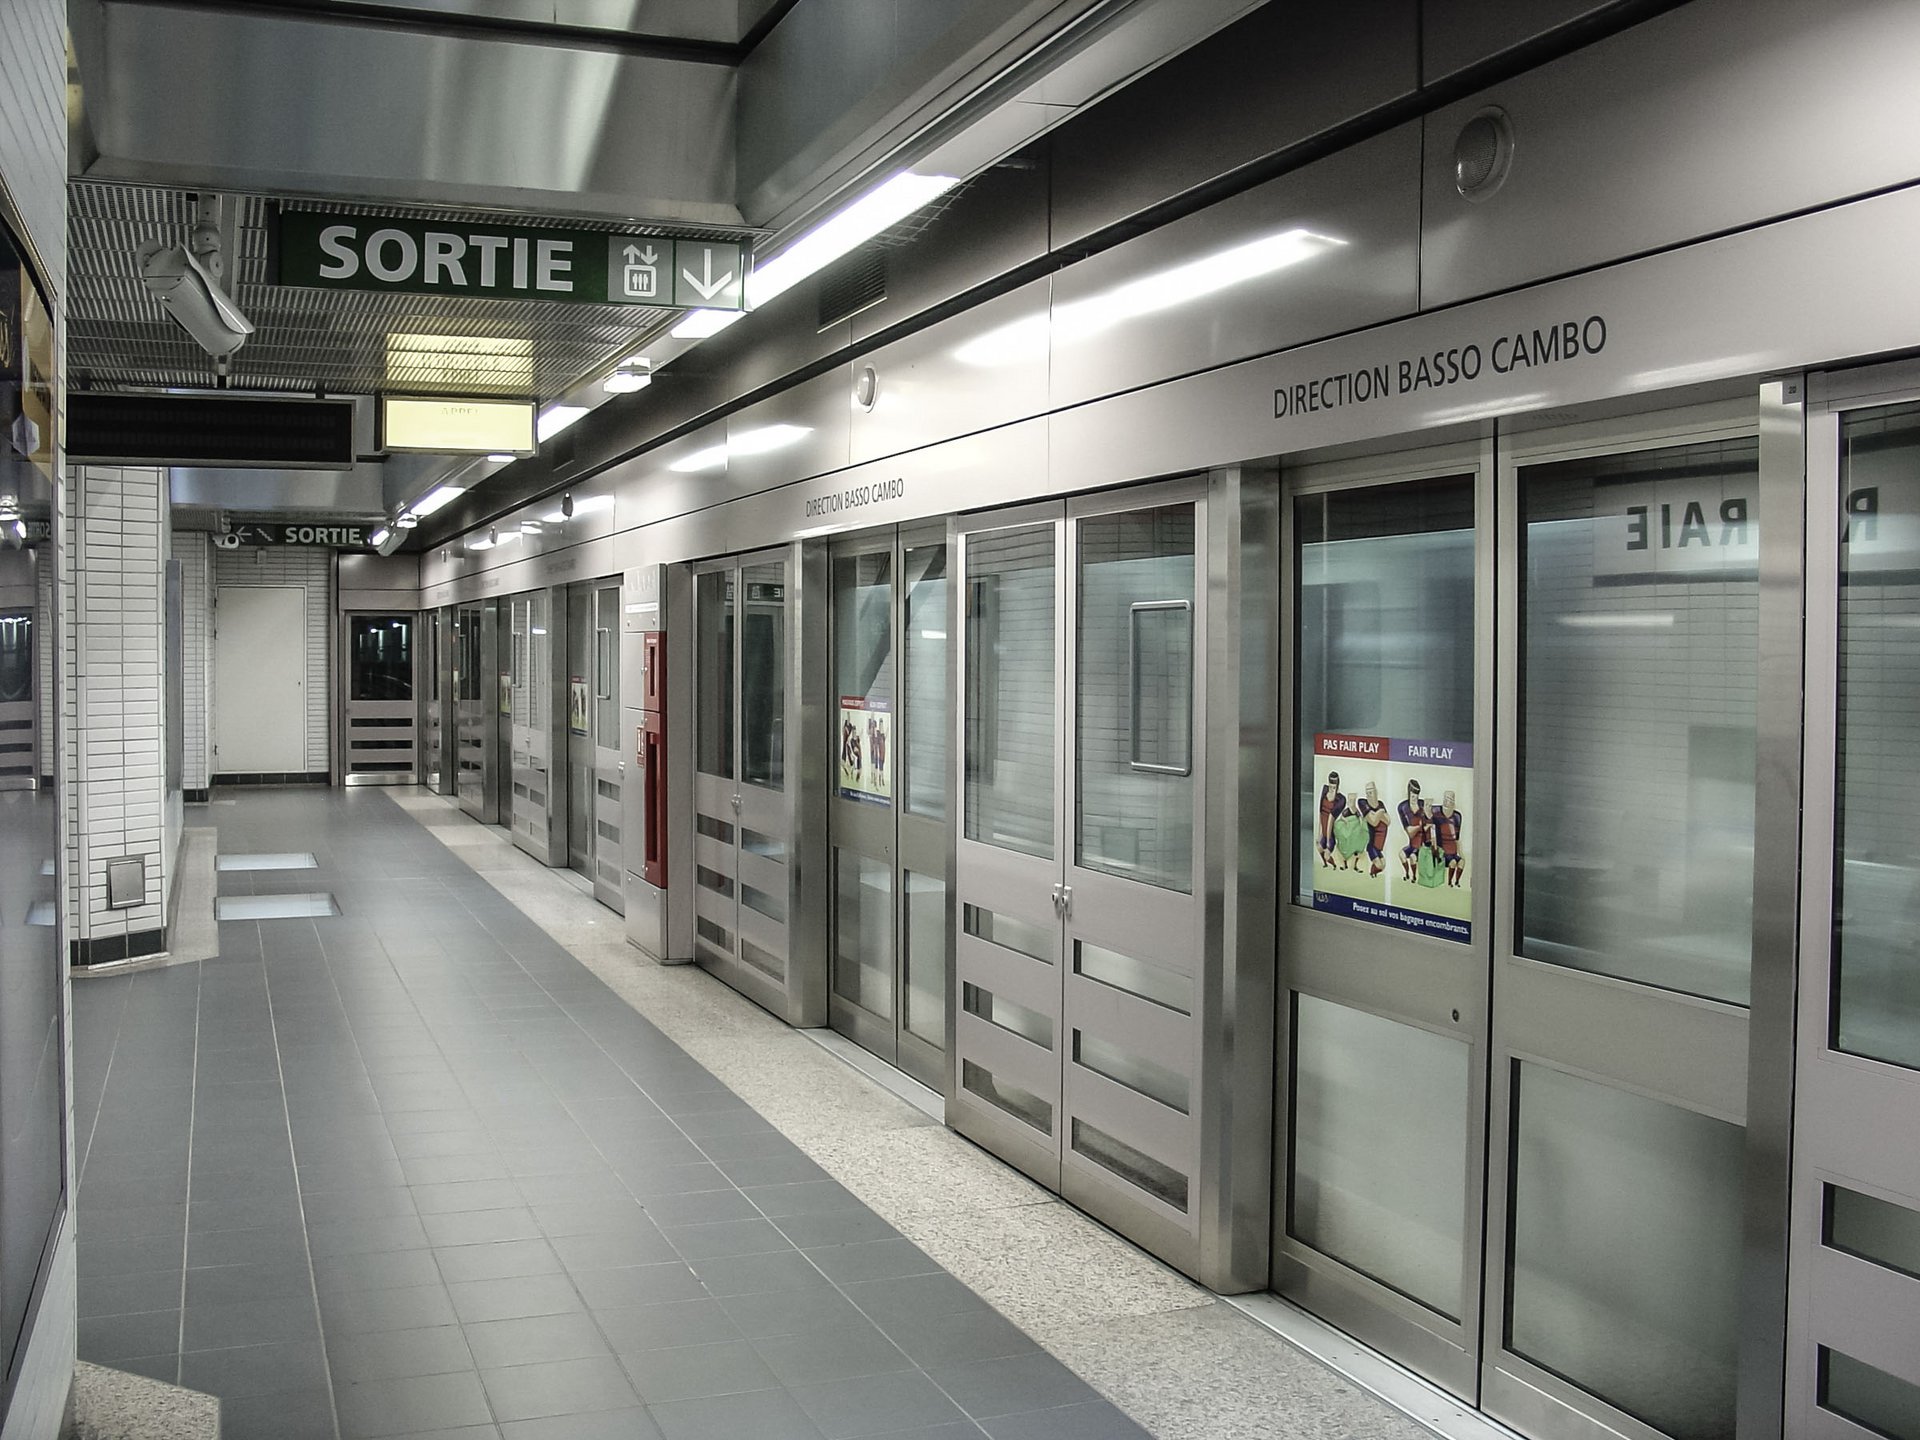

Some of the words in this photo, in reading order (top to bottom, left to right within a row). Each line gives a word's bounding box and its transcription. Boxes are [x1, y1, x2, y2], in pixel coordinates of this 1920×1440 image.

[319, 224, 574, 292] SORTIE
[1273, 364, 1389, 419] DIRECTION
[1399, 344, 1482, 394] BASSO
[1491, 315, 1607, 374] CAMBO
[806, 493, 843, 517] DIRECTION
[845, 487, 869, 509] BASSO
[872, 478, 903, 502] CAMBO
[285, 526, 361, 545] SORTIE
[1323, 739, 1338, 750] PAS
[1339, 740, 1357, 752] FAIR
[1358, 742, 1380, 754] PLAY
[1408, 745, 1428, 758] FAIR
[1430, 747, 1454, 760] PLAY
[1389, 911, 1399, 920] vos
[1400, 912, 1424, 926] bagages
